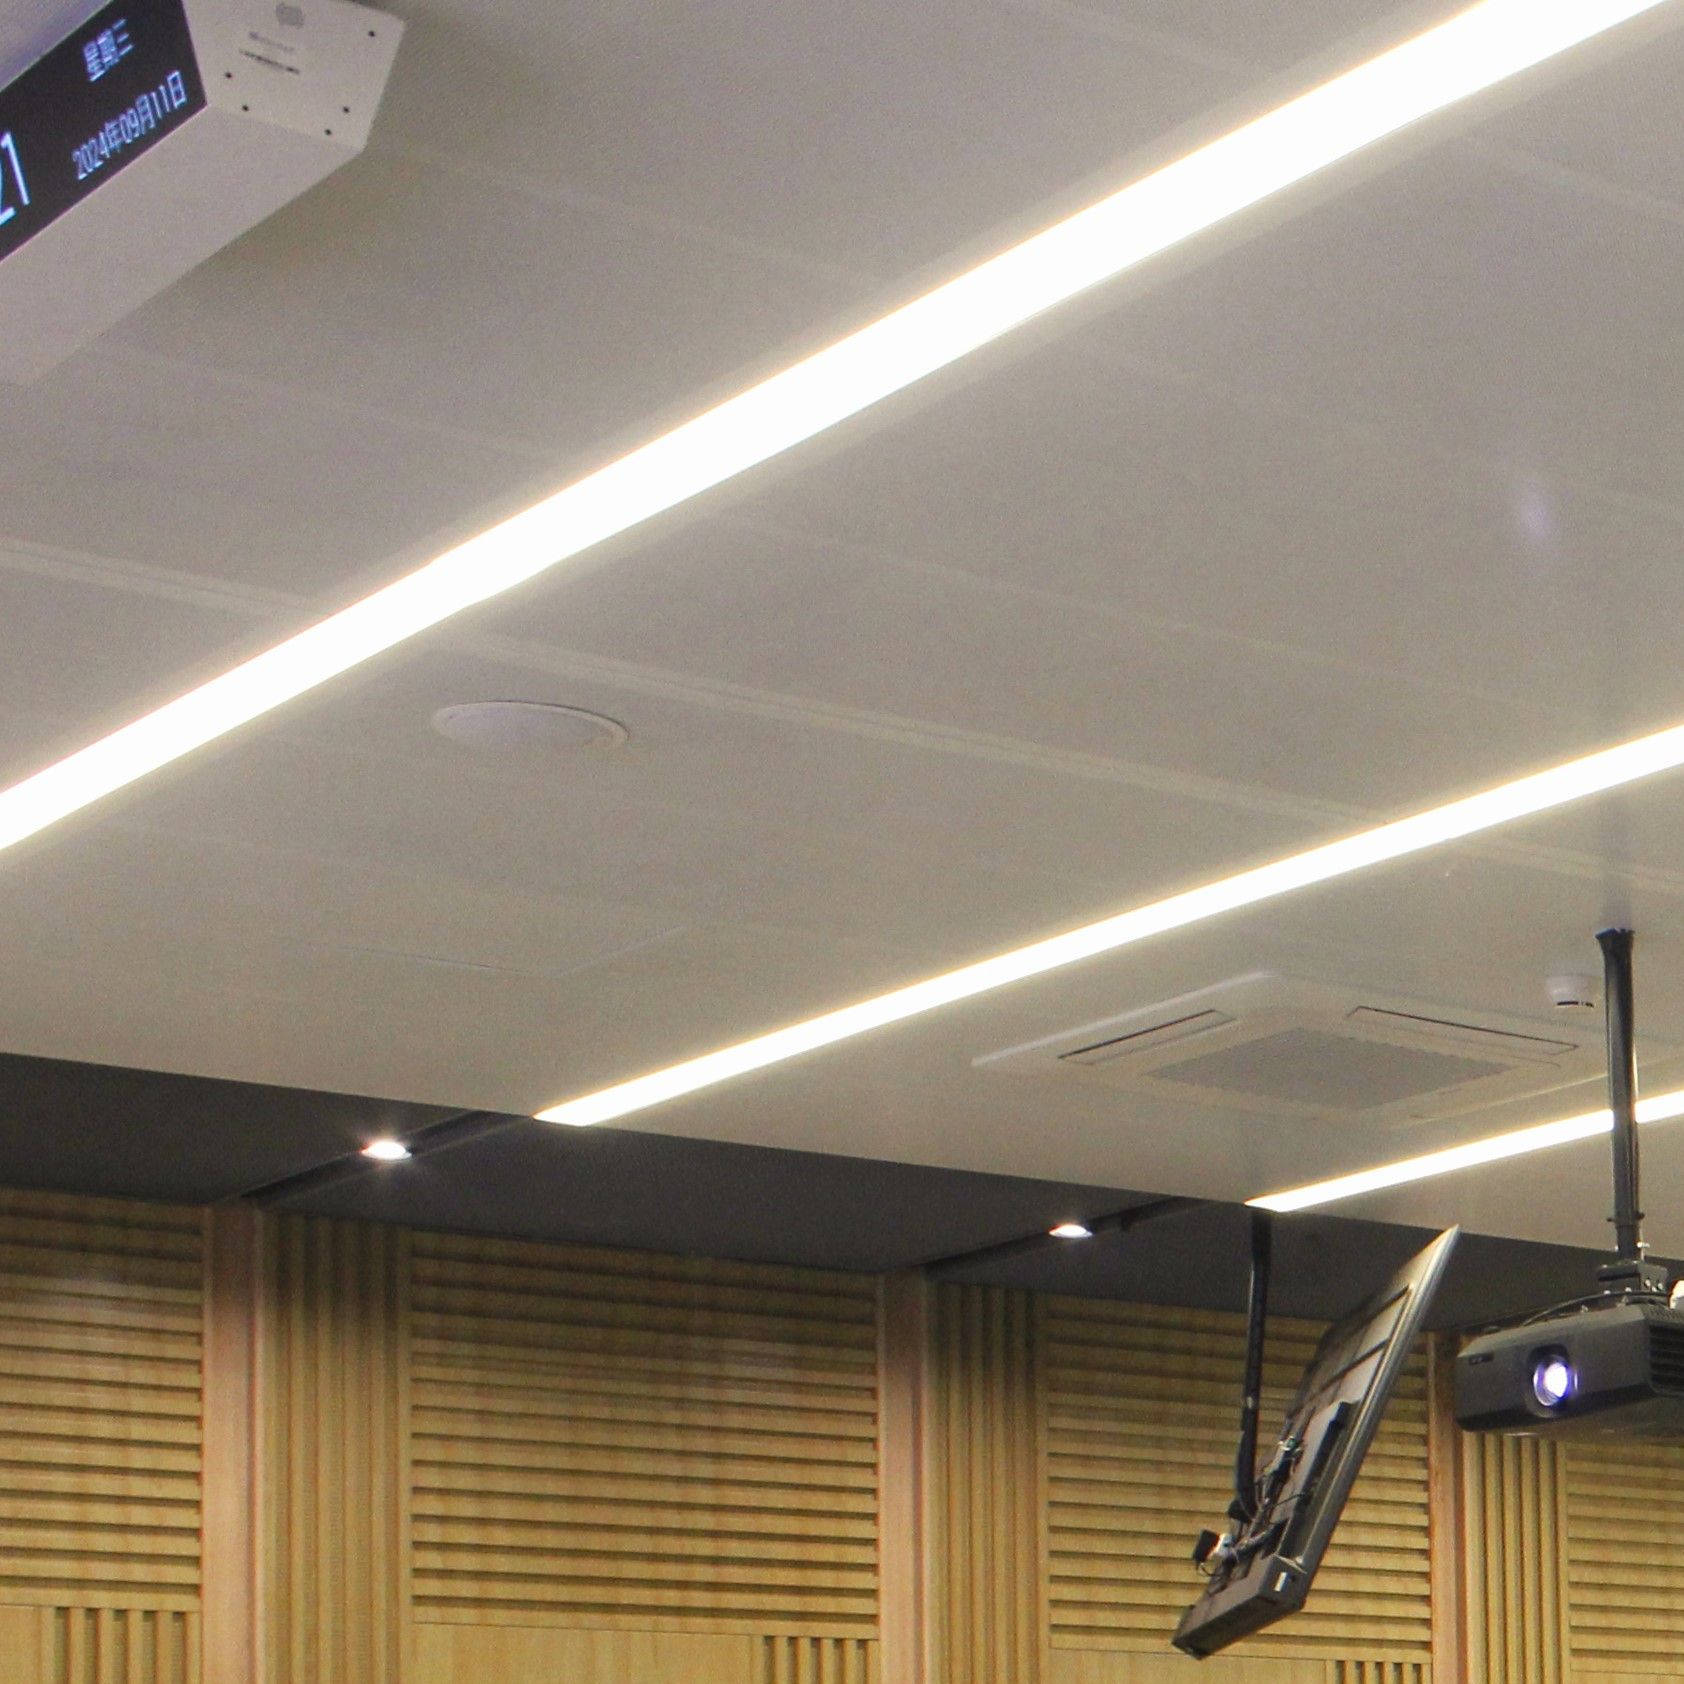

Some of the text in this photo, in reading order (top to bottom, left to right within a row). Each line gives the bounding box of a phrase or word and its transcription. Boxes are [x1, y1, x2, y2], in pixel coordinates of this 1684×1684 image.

[83, 18, 135, 82] 星期三
[72, 69, 188, 181] 2024年09月11日
